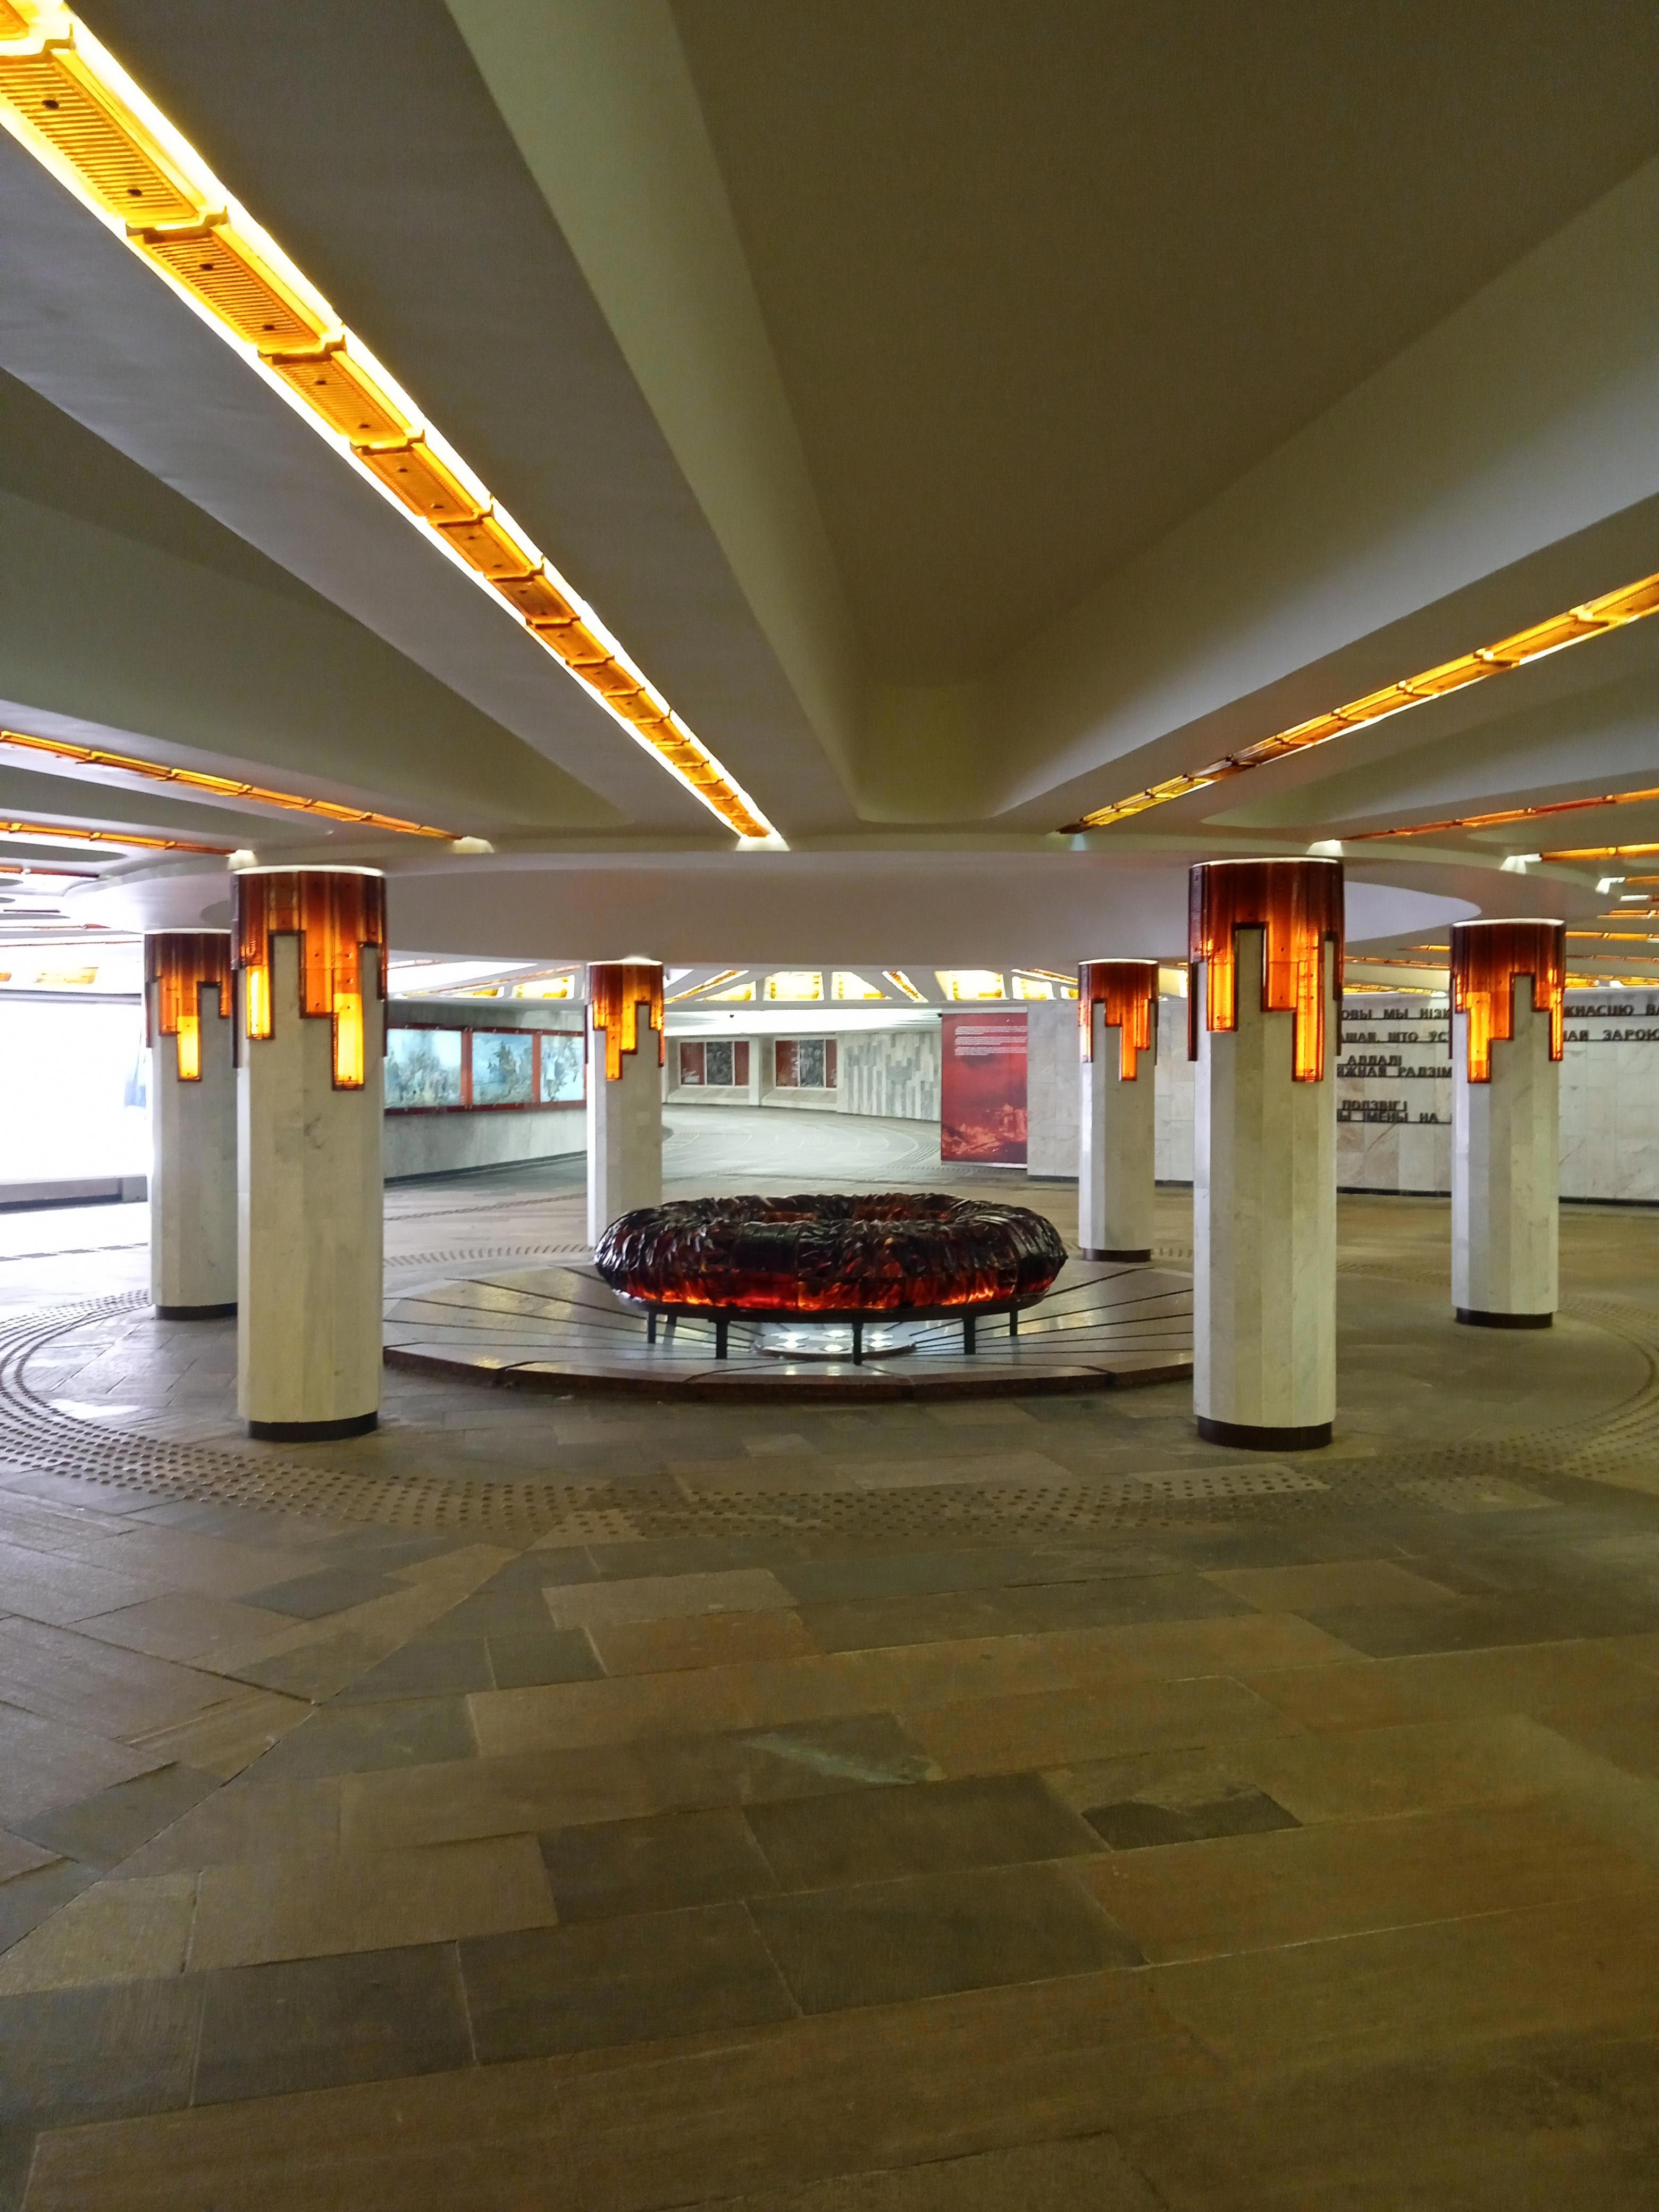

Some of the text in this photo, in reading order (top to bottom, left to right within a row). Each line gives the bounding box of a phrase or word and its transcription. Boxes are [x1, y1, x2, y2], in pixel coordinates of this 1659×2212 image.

[1384, 1009, 1409, 1019] МЫ
[1388, 1032, 1418, 1042] ШТО
[1419, 1112, 1438, 1124] НА
